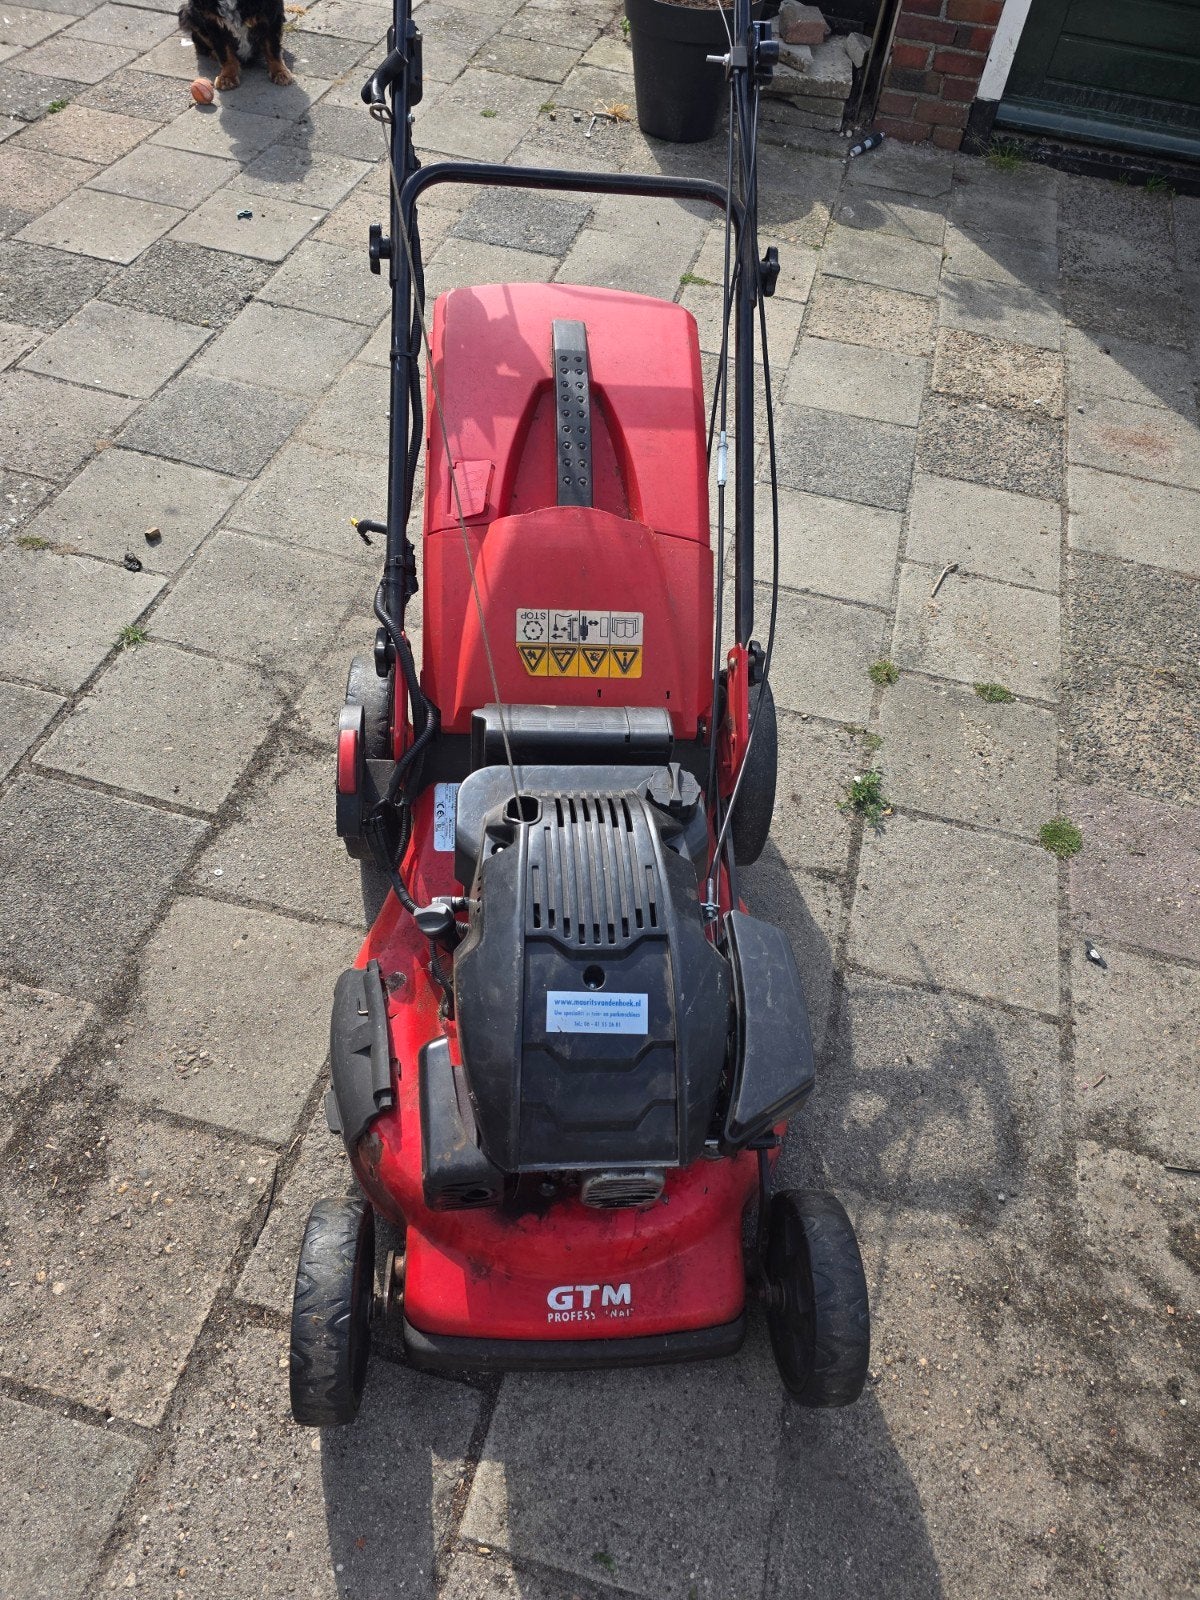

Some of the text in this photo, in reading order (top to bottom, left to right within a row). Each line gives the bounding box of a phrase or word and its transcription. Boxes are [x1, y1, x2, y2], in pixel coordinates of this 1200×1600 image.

[520, 611, 546, 620] STOP
[554, 998, 641, 1007] www.mauritsvandenhoek.nl
[547, 1283, 631, 1311] GTM
